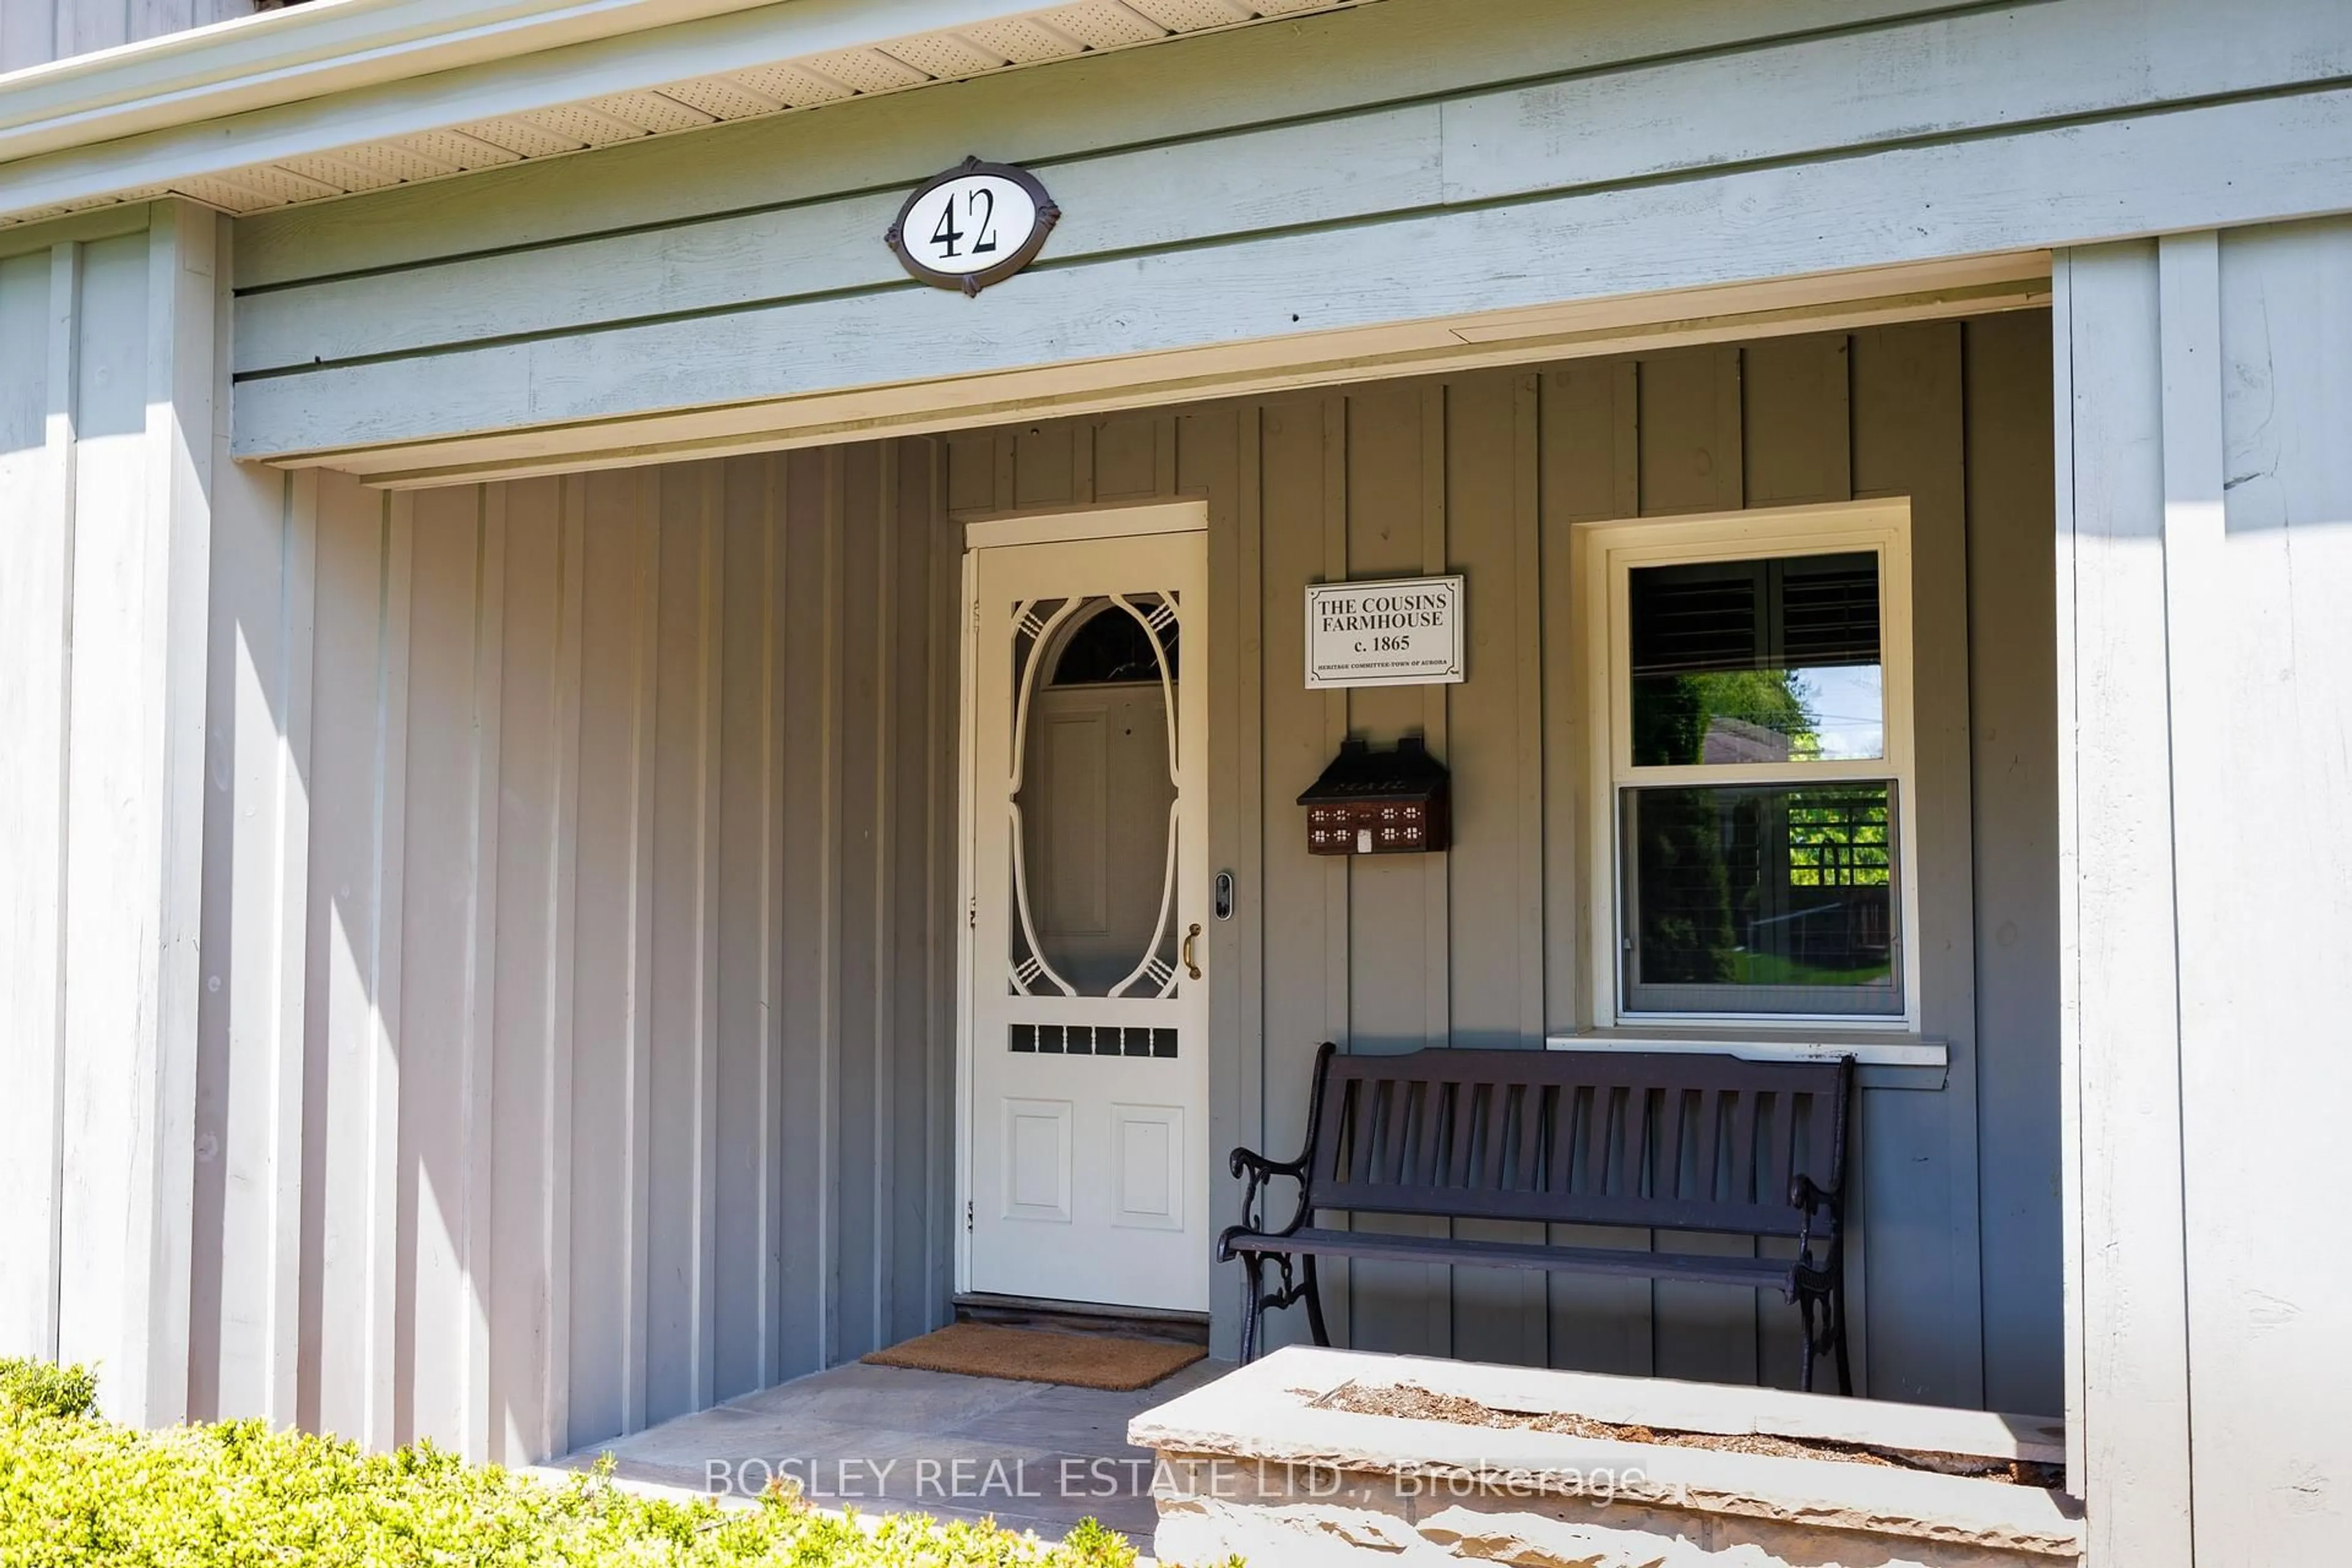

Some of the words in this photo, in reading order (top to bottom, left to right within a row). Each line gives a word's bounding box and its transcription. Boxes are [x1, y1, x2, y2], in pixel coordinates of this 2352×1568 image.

[930, 188, 997, 259] 42
[1318, 598, 1357, 616] THE
[1362, 594, 1447, 613] COUSINS
[1323, 611, 1443, 631] FARMHOUSE
[1354, 641, 1367, 652] c.
[1373, 635, 1410, 651] 1865
